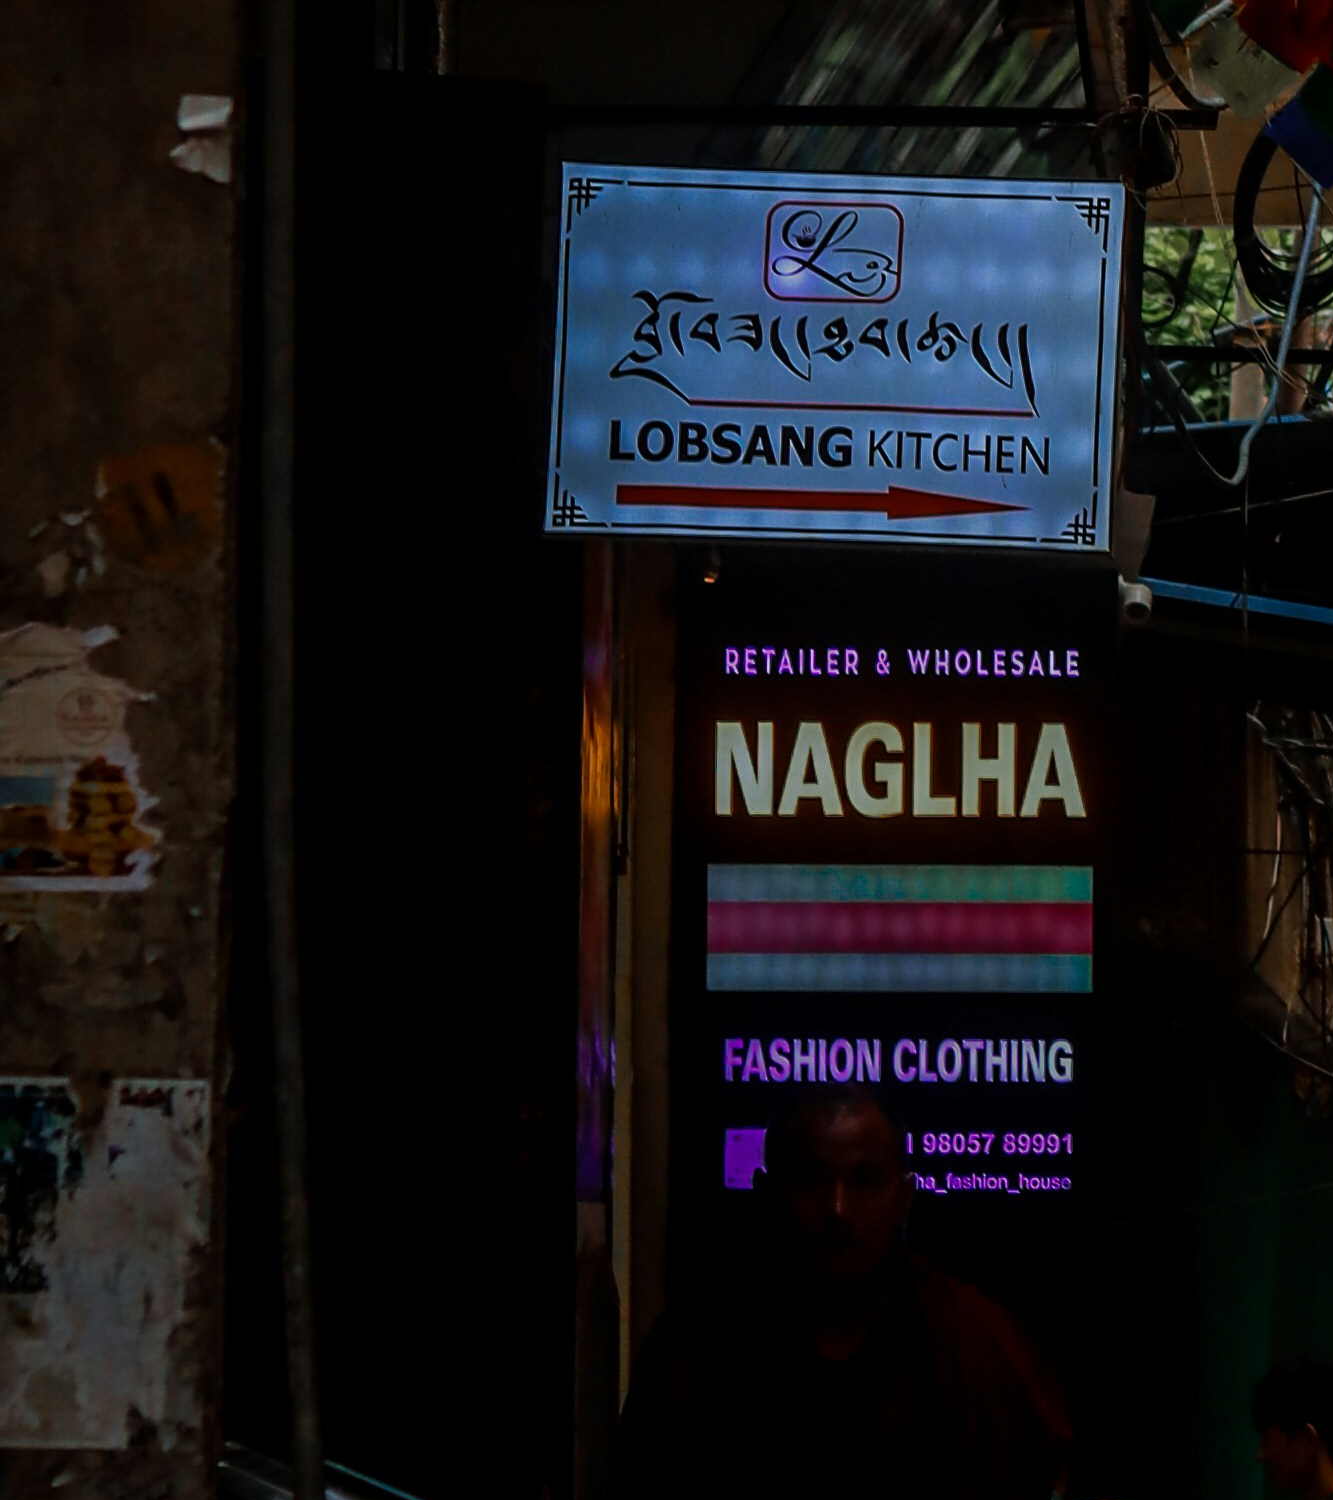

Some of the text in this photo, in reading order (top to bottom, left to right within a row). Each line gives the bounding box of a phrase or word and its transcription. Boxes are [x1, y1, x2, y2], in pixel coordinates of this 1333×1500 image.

[610, 420, 1051, 475] LOBSANG KITCHEN
[724, 645, 1082, 679] RETAILER & WHOLESALE
[714, 719, 1088, 820] NAGLHA
[724, 1036, 1075, 1084] FASHION CLOTHING
[922, 1131, 995, 1155] 98057
[1002, 1132, 1074, 1155] 89991
[914, 1172, 1073, 1194] ha_fashion_house
